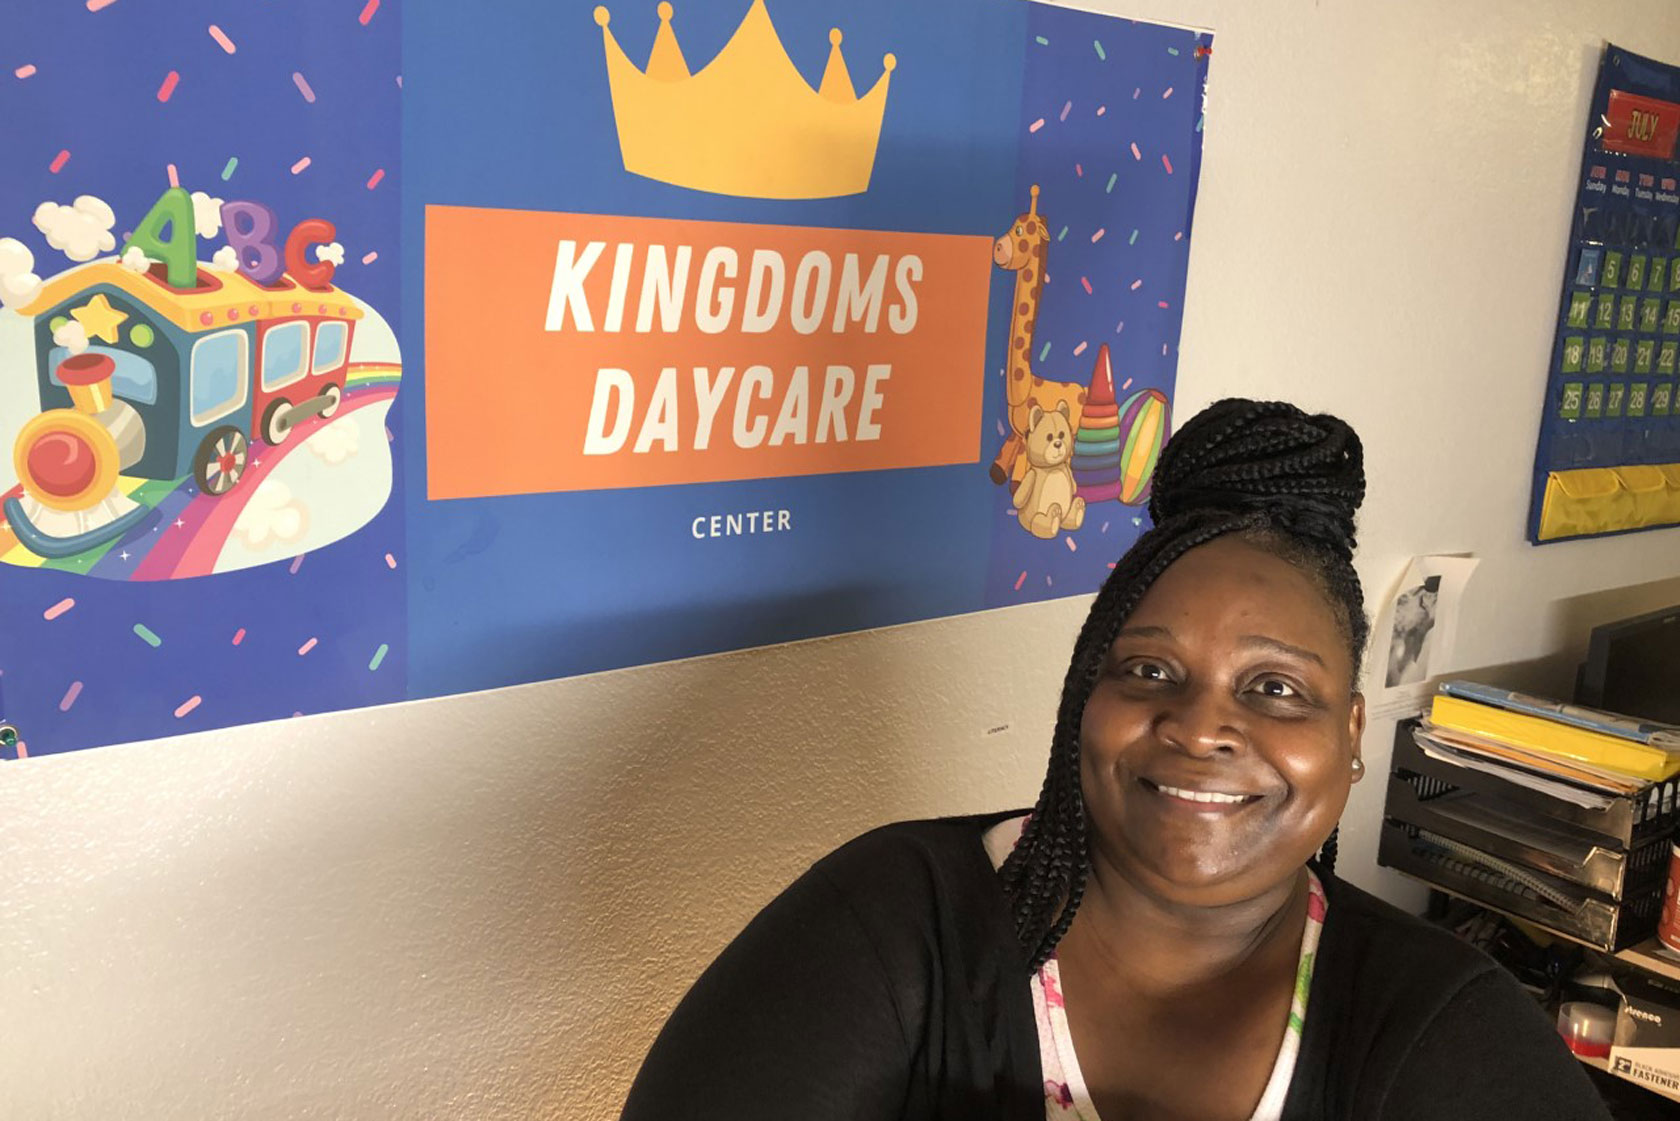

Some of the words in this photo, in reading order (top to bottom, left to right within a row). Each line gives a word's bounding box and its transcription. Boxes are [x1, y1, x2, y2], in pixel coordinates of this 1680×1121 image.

[1627, 110, 1659, 142] JULY
[120, 186, 338, 289] ABC
[1607, 260, 1616, 279] 5
[1631, 263, 1640, 282] 6
[1653, 266, 1662, 283] 7
[544, 239, 924, 335] KINGDOMS
[1571, 301, 1586, 320] 11
[1599, 302, 1611, 321] 12
[1620, 303, 1633, 322] 13
[1644, 306, 1657, 324] 14
[1668, 308, 1680, 326] 15
[1565, 344, 1580, 364] 18
[1589, 346, 1602, 364] 19
[1614, 347, 1627, 364] 20
[1637, 349, 1650, 366] 21
[1661, 349, 1674, 367] 22
[583, 364, 892, 456] DAYCARE
[1563, 391, 1580, 410] 25
[1588, 391, 1601, 410] 26
[1608, 391, 1623, 409] 27
[1630, 391, 1644, 409] 28
[1654, 391, 1669, 408] 29
[692, 509, 792, 539] CENTER
